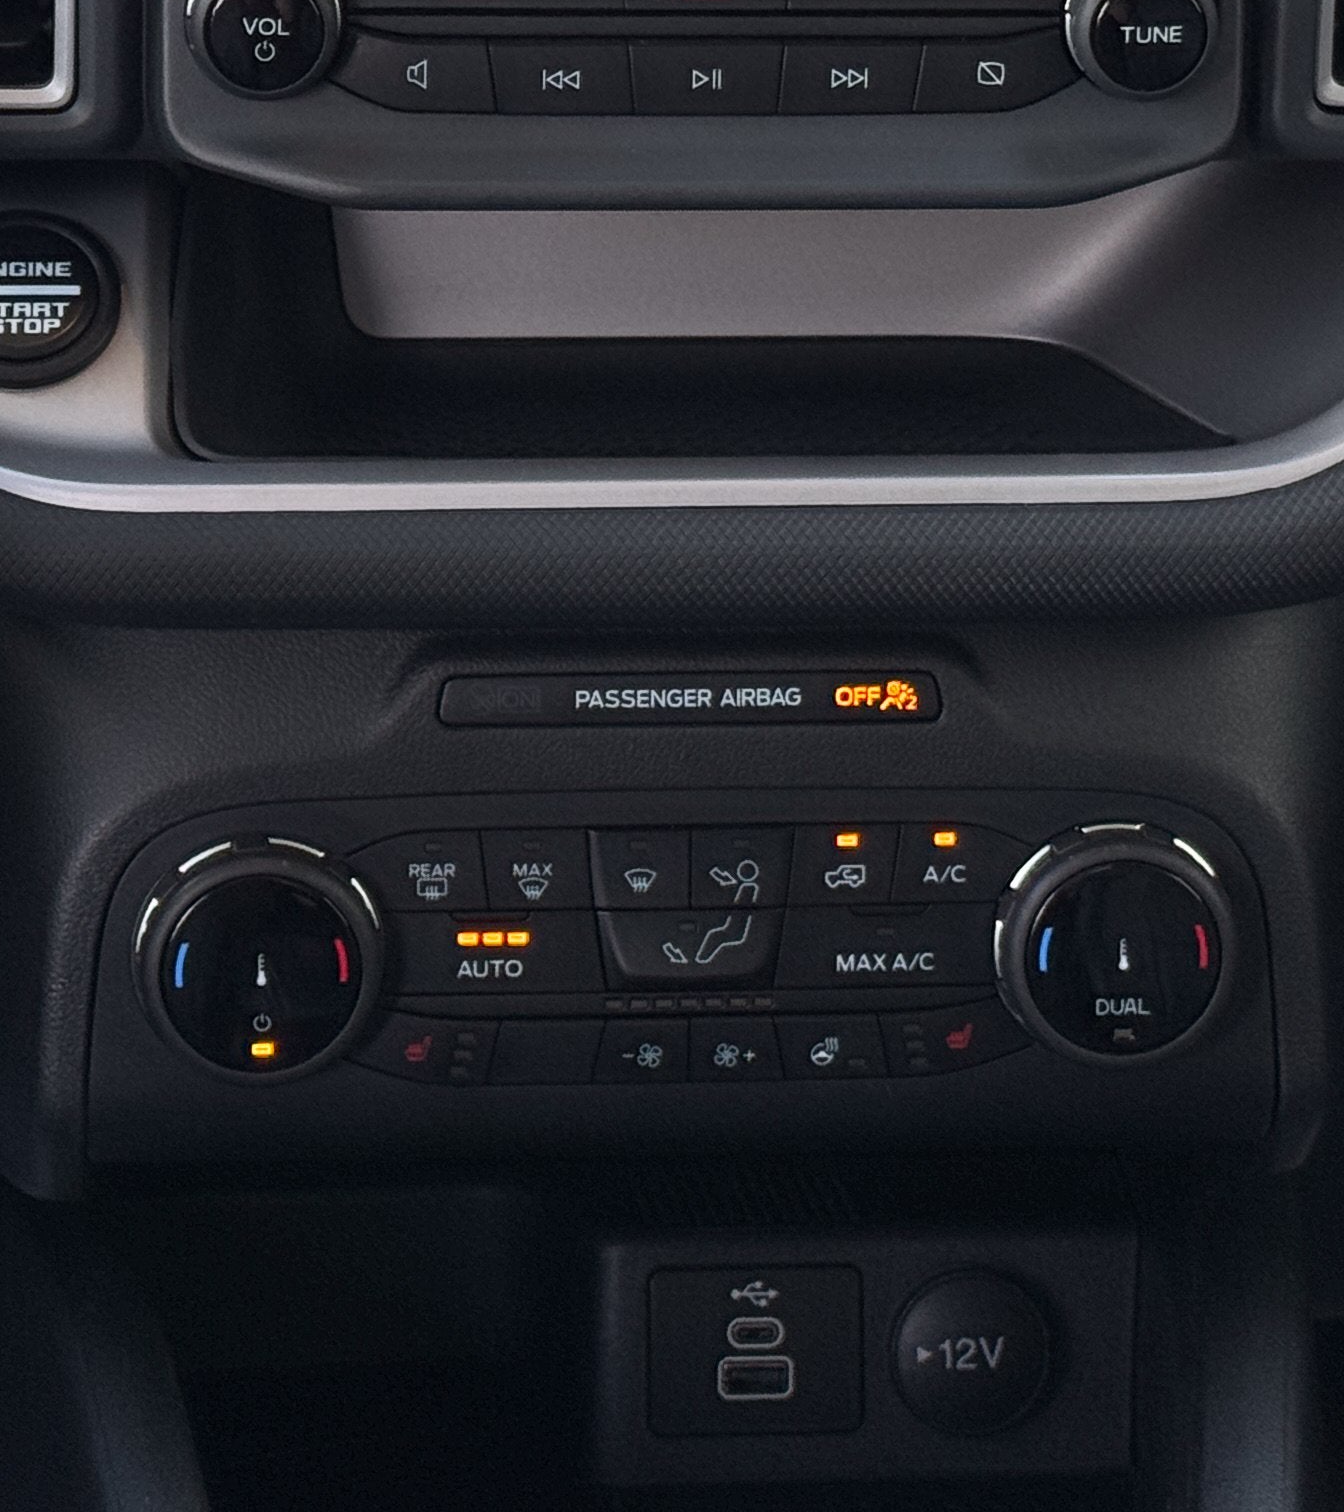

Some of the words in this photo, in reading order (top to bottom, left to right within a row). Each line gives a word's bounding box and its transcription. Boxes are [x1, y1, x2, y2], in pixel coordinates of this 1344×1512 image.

[243, 18, 290, 37] VOL
[1120, 26, 1182, 43] TUNE
[574, 689, 711, 709] PASSENGER
[720, 688, 802, 708] AIRBAG
[835, 685, 881, 707] OFF
[409, 864, 456, 878] REAR
[513, 863, 552, 878] MAX
[923, 866, 966, 884] A/C
[457, 959, 523, 979] AUTO
[836, 952, 886, 972] MAX
[892, 952, 935, 972] A/C
[1095, 998, 1151, 1017] DUAL
[939, 1336, 1005, 1371] 12V
